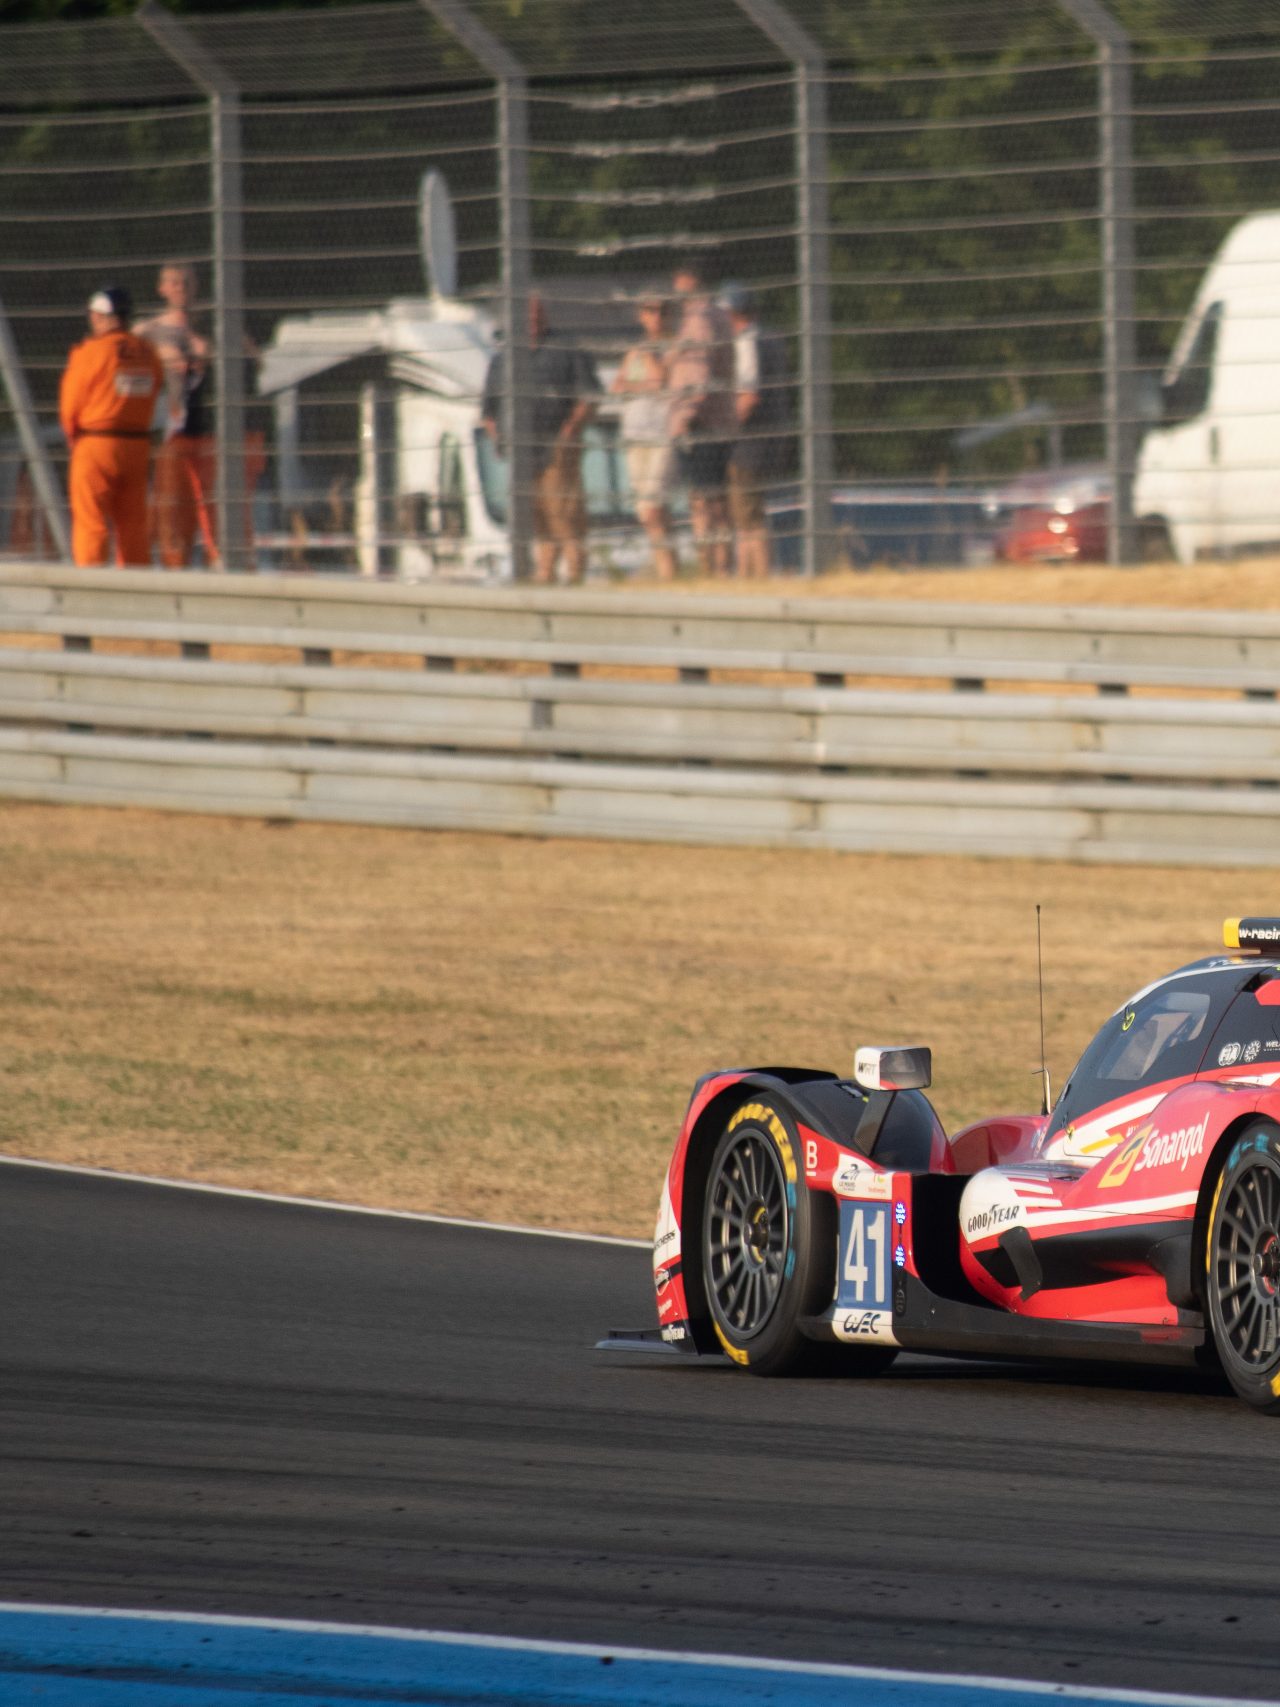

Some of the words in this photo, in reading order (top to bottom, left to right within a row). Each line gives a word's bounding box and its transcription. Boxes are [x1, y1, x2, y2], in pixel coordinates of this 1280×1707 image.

[1134, 1111, 1210, 1173] Sonangol
[967, 1203, 1021, 1232] GOODYEAR
[843, 1208, 886, 1303] 41
[843, 1312, 881, 1335] WEC
